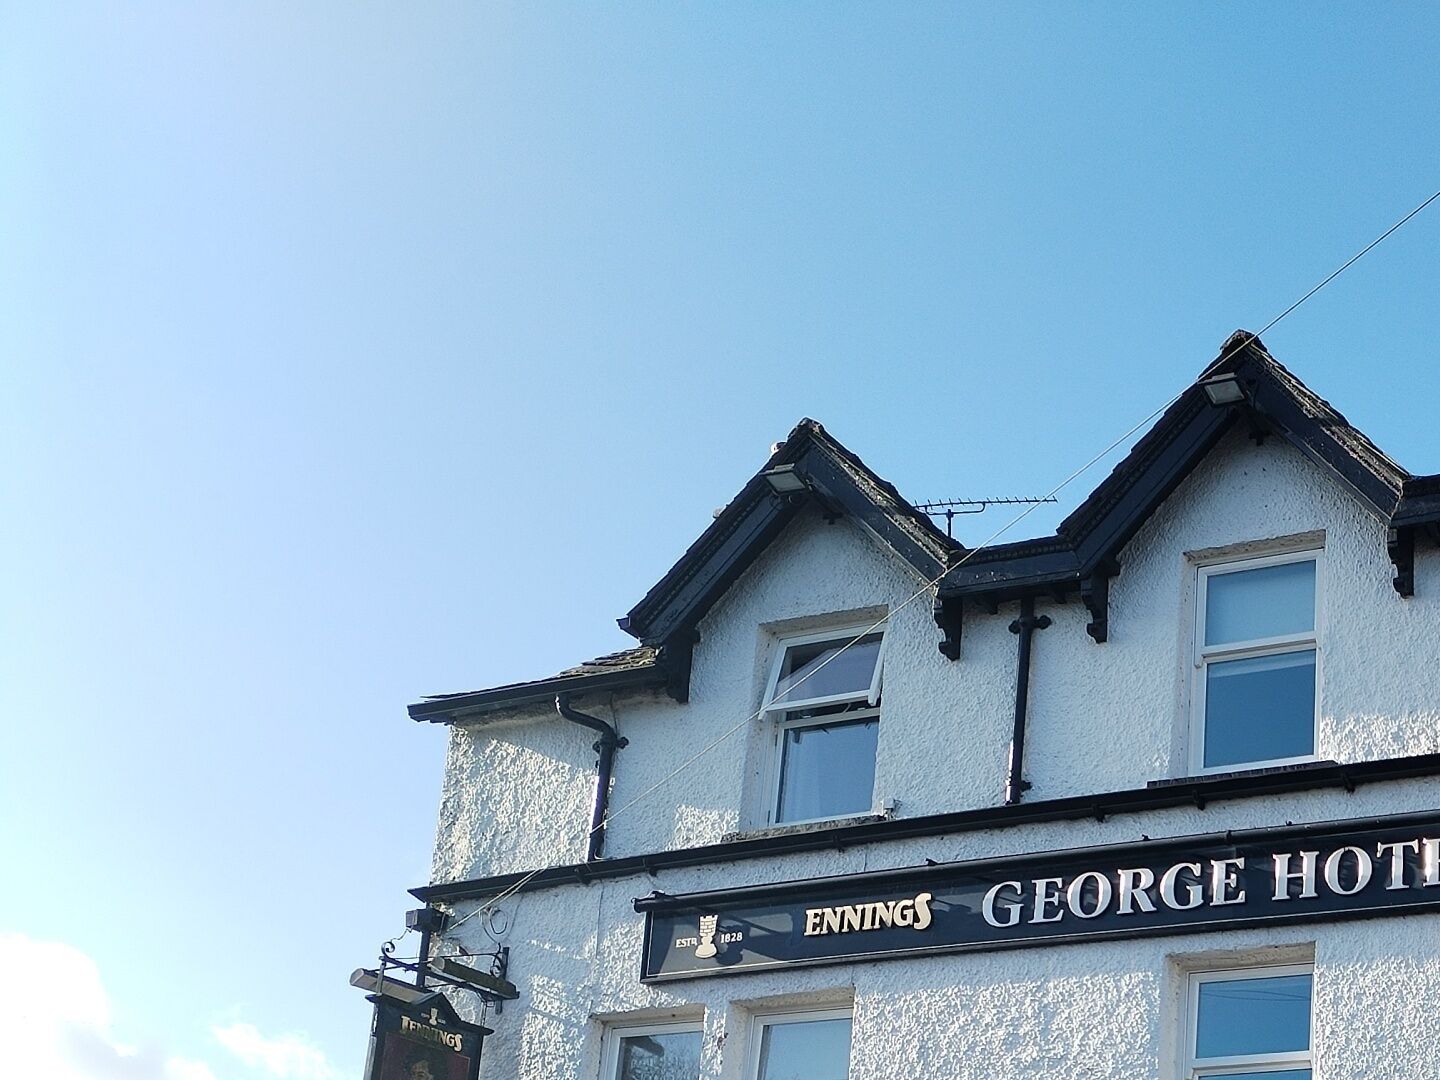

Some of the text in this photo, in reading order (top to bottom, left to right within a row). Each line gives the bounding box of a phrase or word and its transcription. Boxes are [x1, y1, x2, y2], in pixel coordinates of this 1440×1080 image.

[803, 892, 932, 936] ENNINGS
[982, 857, 1246, 928] GEORGE
[720, 931, 743, 944] 1828
